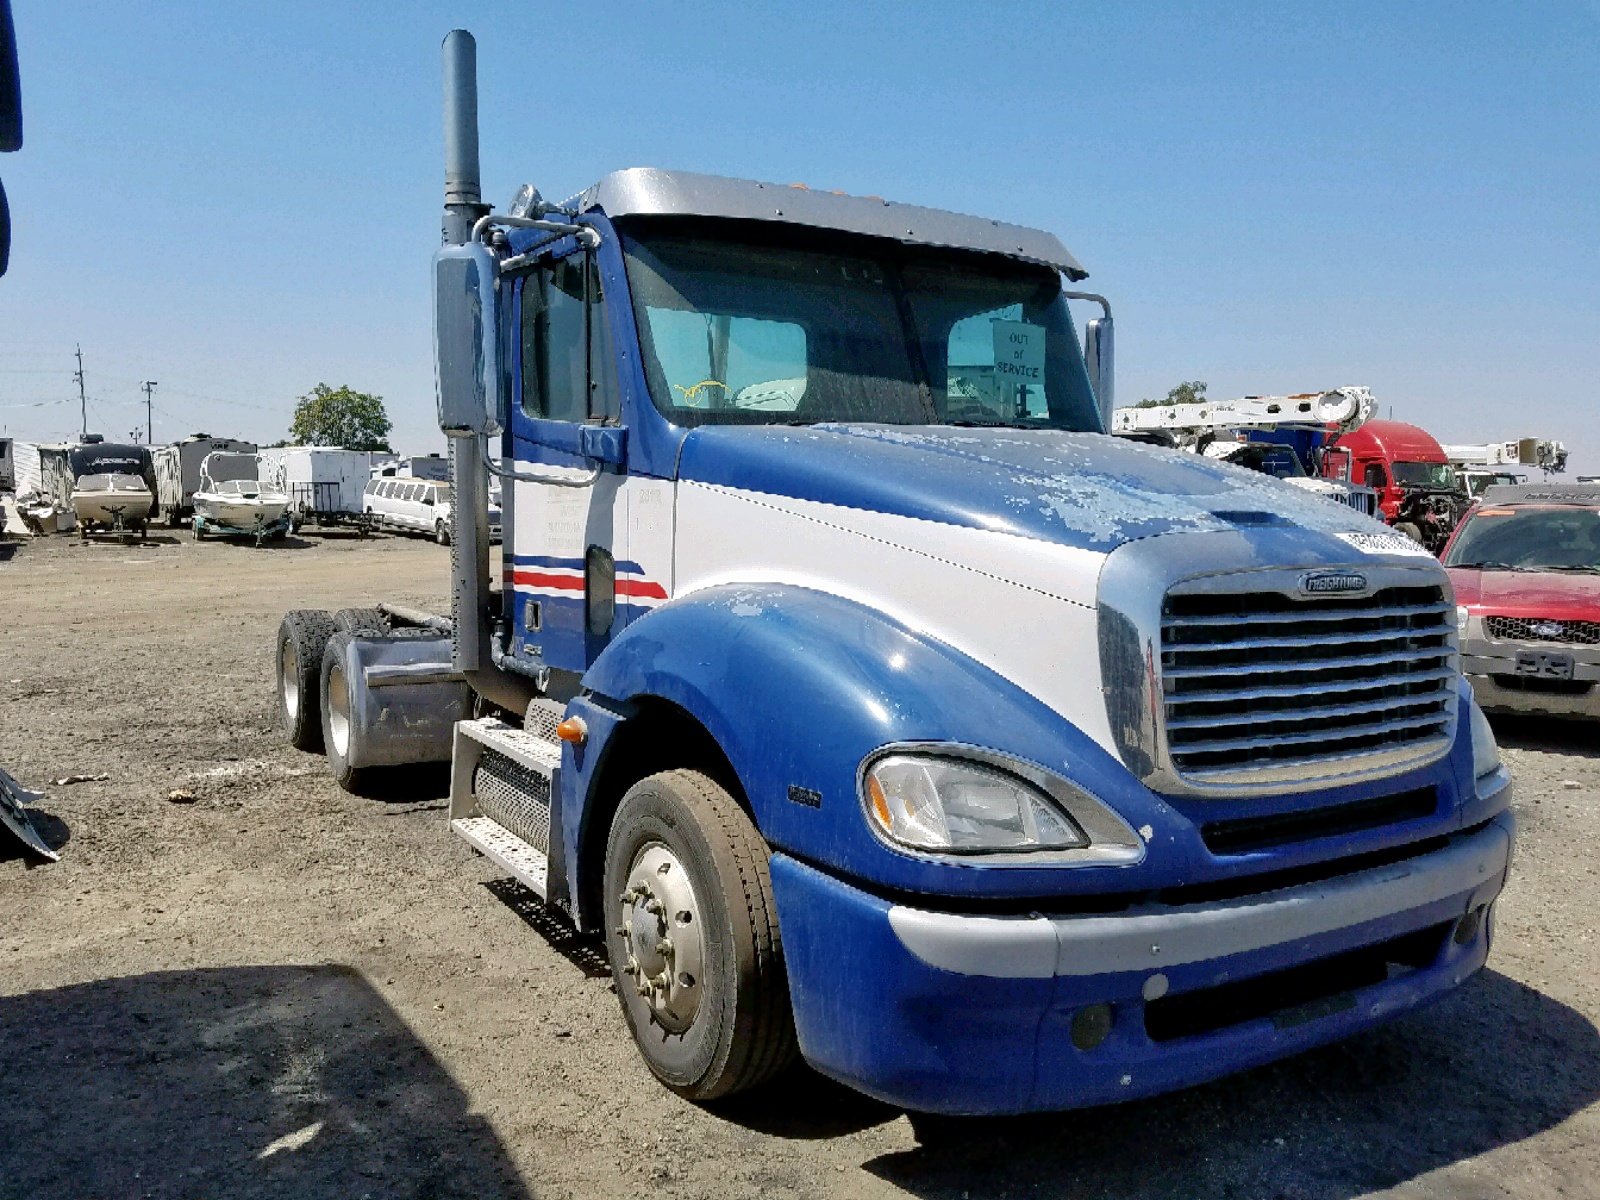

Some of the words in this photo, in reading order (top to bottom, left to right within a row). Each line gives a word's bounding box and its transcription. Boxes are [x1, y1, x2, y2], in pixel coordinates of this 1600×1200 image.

[1009, 332, 1030, 345] OUT
[997, 361, 1039, 378] SERVICE
[1307, 577, 1366, 590] FREIGHTLINER
